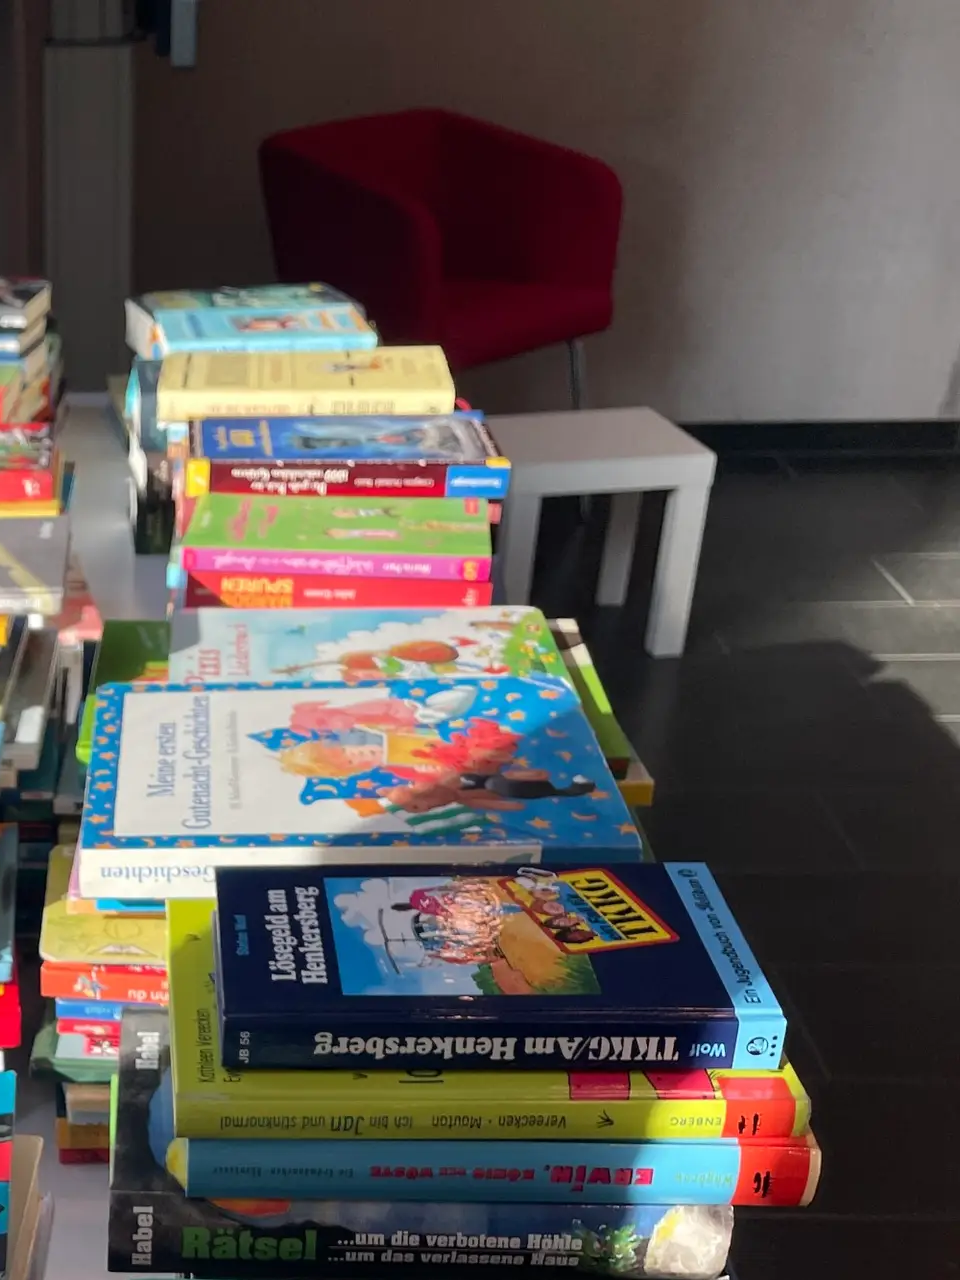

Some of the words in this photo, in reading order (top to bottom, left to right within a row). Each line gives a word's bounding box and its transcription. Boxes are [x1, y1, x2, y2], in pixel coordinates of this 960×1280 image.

[157, 722, 177, 755] ersten
[181, 695, 213, 829] Gutenacht-Geschichten
[146, 760, 177, 798] Meine
[101, 865, 217, 884] Geschichten
[266, 890, 288, 913] am
[569, 877, 658, 941] TKKG
[707, 913, 723, 930] von
[293, 885, 329, 984] Henkersberg
[265, 914, 299, 982] Lösegeld
[715, 930, 754, 987] Jugendbuch
[742, 989, 762, 1004] Ein
[136, 1032, 159, 1069] Habel
[239, 1031, 251, 1047] 56
[313, 1030, 519, 1064] Henkersberg
[525, 1036, 680, 1064] TKKG/Am
[690, 1041, 726, 1059] Wolf
[239, 1047, 251, 1063] JB
[220, 1115, 300, 1131] stinknormal
[302, 1115, 327, 1131] und
[330, 1114, 366, 1137] Jan
[369, 1115, 390, 1131] bin
[431, 1115, 483, 1131] Mouton
[497, 1114, 568, 1131] Vereecken
[131, 1206, 153, 1265] Habel
[180, 1226, 316, 1260] Rätsel
[391, 1231, 420, 1247] die
[426, 1231, 522, 1249] verbotene
[527, 1231, 583, 1251] Höhle
[381, 1251, 414, 1264] das
[420, 1252, 526, 1265] verlassene
[531, 1253, 580, 1267] Haus
